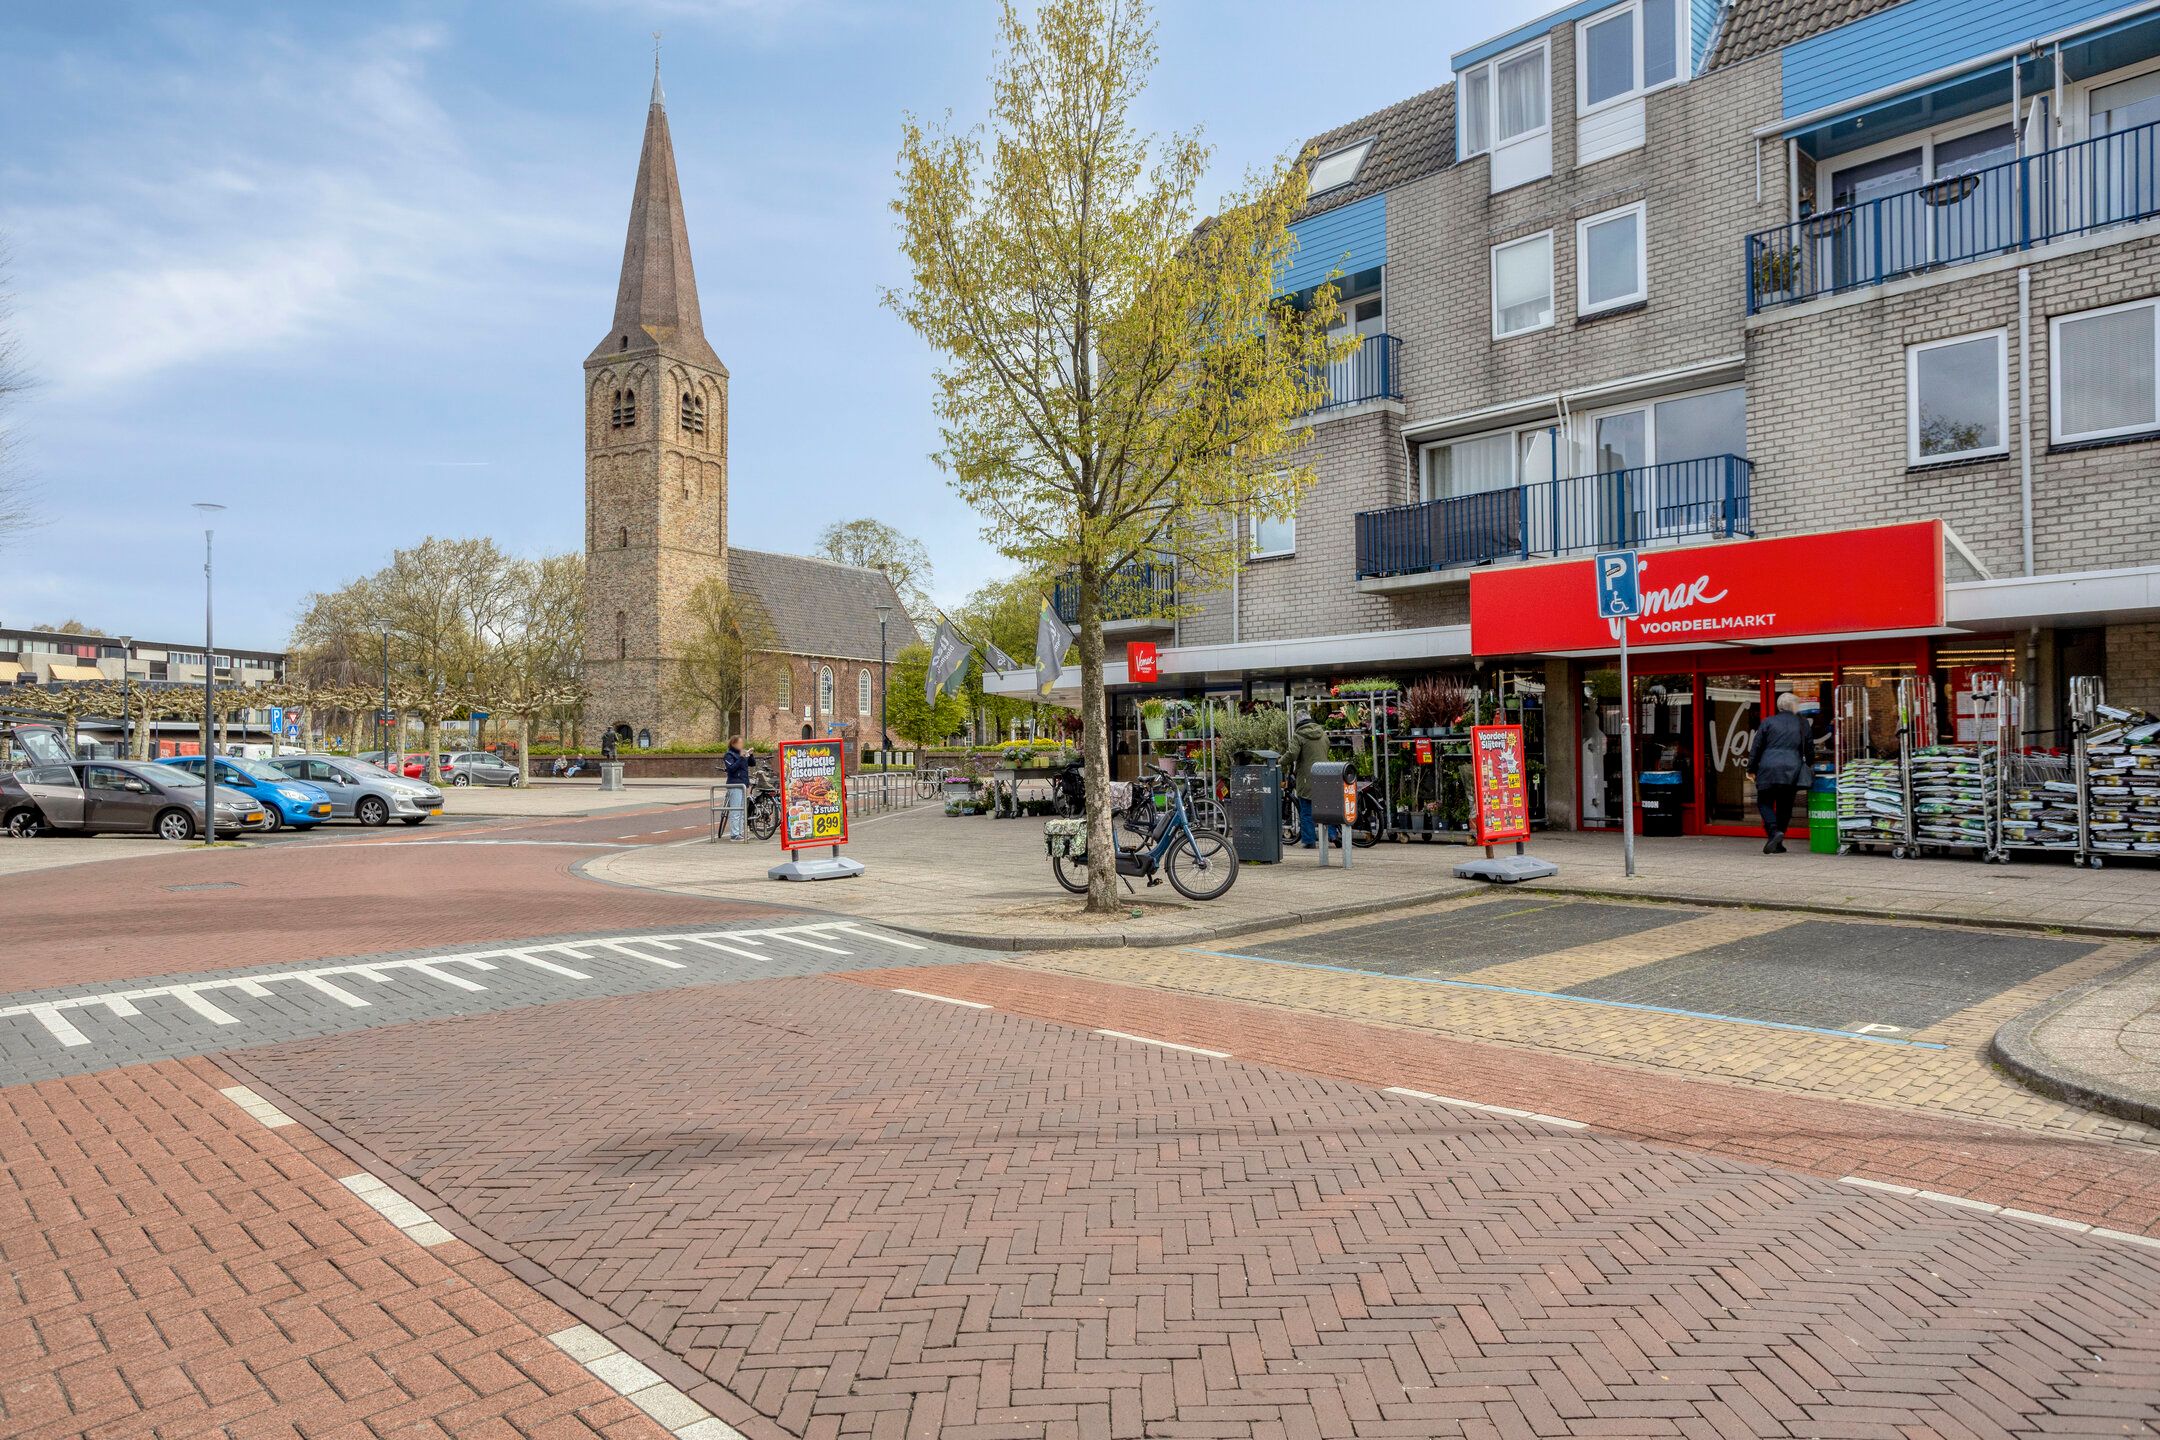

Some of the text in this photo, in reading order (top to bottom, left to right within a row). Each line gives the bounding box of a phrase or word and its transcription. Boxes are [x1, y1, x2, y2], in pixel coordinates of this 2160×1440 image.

[1604, 557, 1627, 591] P
[1641, 613, 1776, 634] VOORDEELMARKT
[1478, 731, 1507, 740] Voordeel
[790, 756, 835, 768] Barbecue
[791, 766, 836, 778] discounter
[814, 805, 839, 814] 3 STUKS
[816, 816, 839, 834] 8.99
